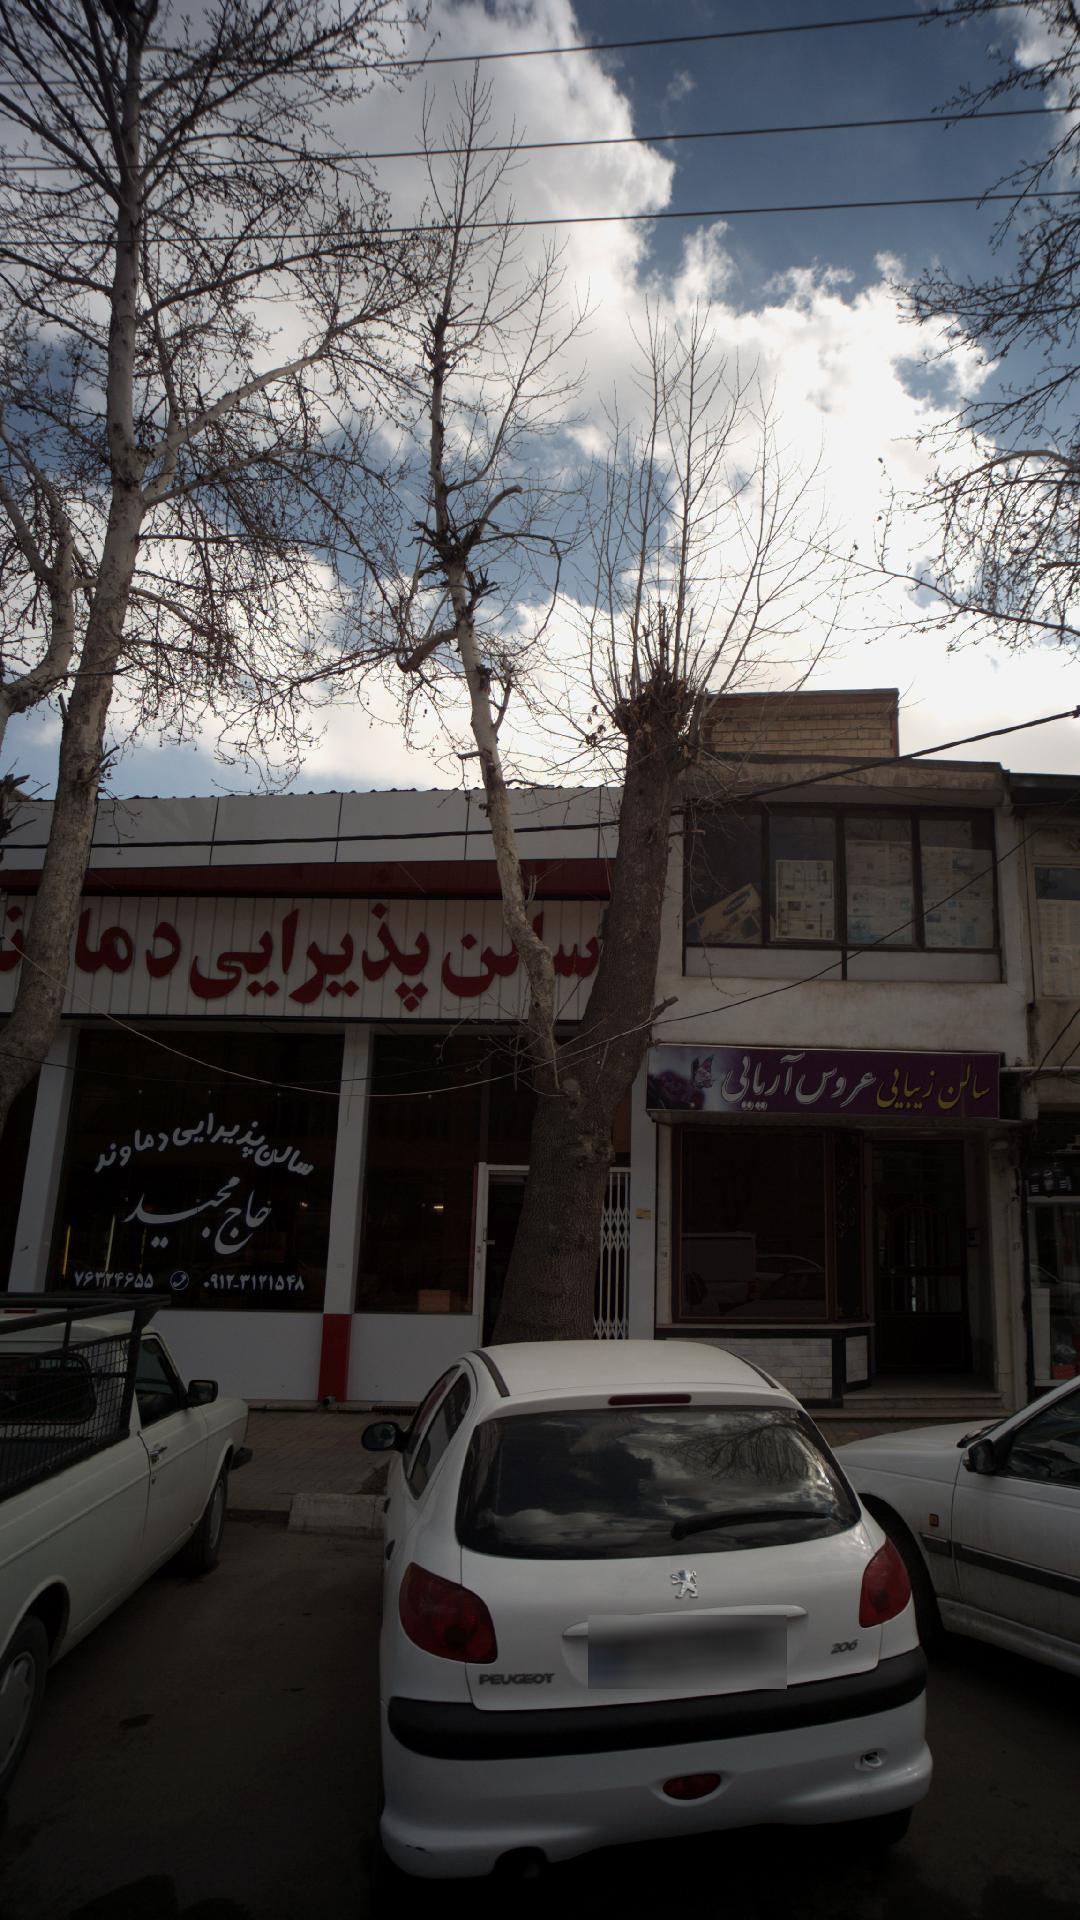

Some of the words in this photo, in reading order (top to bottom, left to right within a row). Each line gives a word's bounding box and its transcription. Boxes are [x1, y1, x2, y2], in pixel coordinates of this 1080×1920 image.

[190, 903, 430, 1012] پذیرایی
[795, 1066, 877, 1109] عروس
[876, 1066, 936, 1110] زیبایی
[938, 1063, 991, 1110] سالن
[94, 1129, 169, 1175] دماوند
[172, 1112, 267, 1158] پذیرایی
[253, 1144, 315, 1176] سالن
[214, 1189, 273, 1255] حاج
[829, 1639, 859, 1655] 206
[478, 1673, 554, 1686] PEUGEOT
